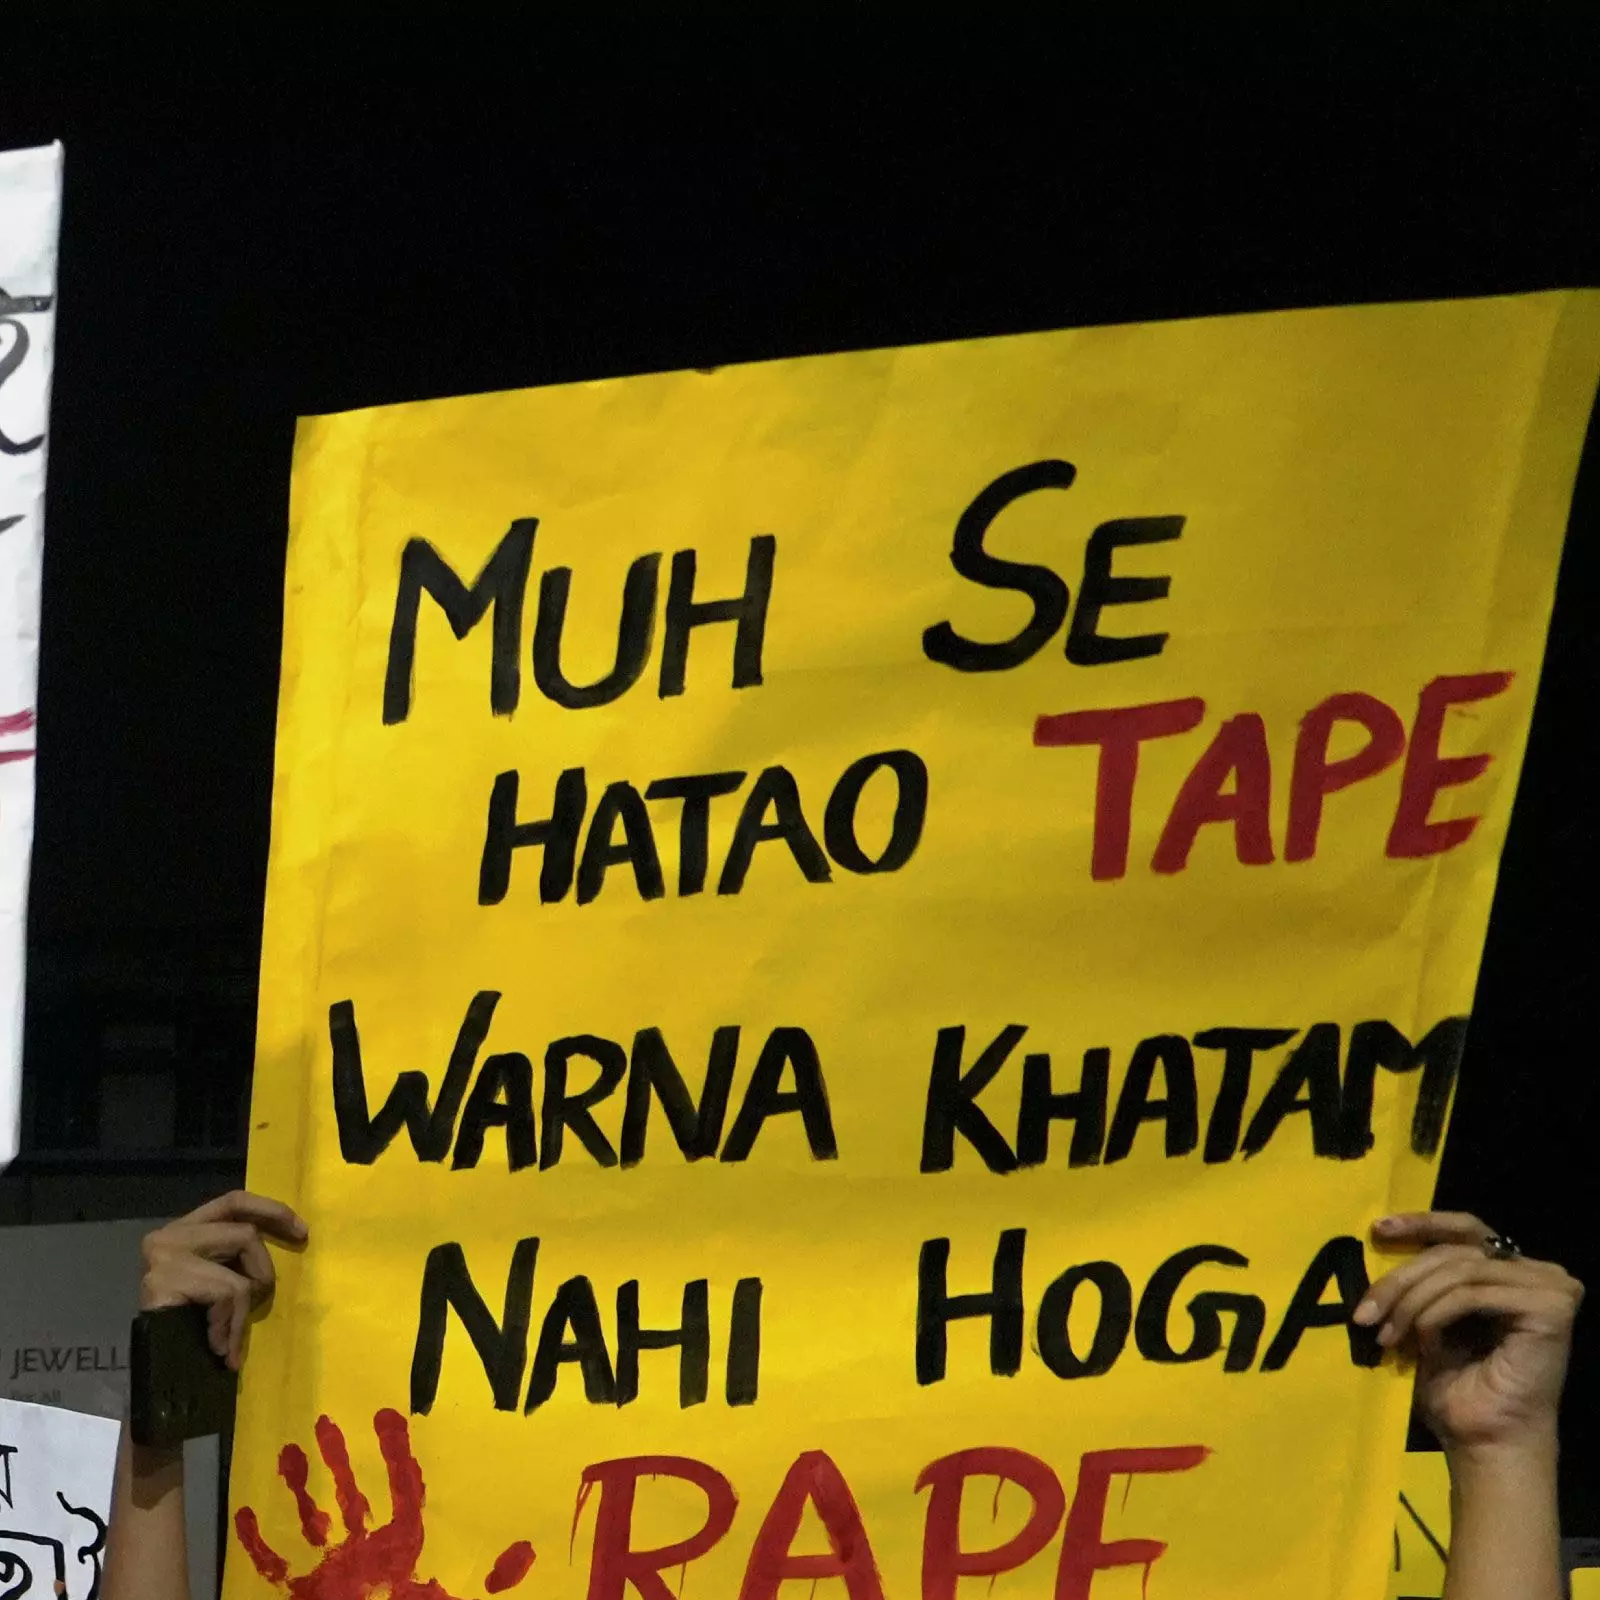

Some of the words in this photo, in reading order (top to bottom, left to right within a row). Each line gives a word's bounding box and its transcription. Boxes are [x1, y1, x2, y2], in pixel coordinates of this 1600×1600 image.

[382, 518, 776, 725] MUH
[921, 458, 1185, 673] SE
[477, 748, 929, 908] HATAO
[1032, 669, 1516, 882] TAPE
[328, 990, 838, 1173] WARNA
[919, 1015, 1470, 1175] KHATAM
[9, 1347, 131, 1380] JEWELL
[408, 1236, 764, 1416] NAHI
[915, 1228, 1383, 1386] HOGA
